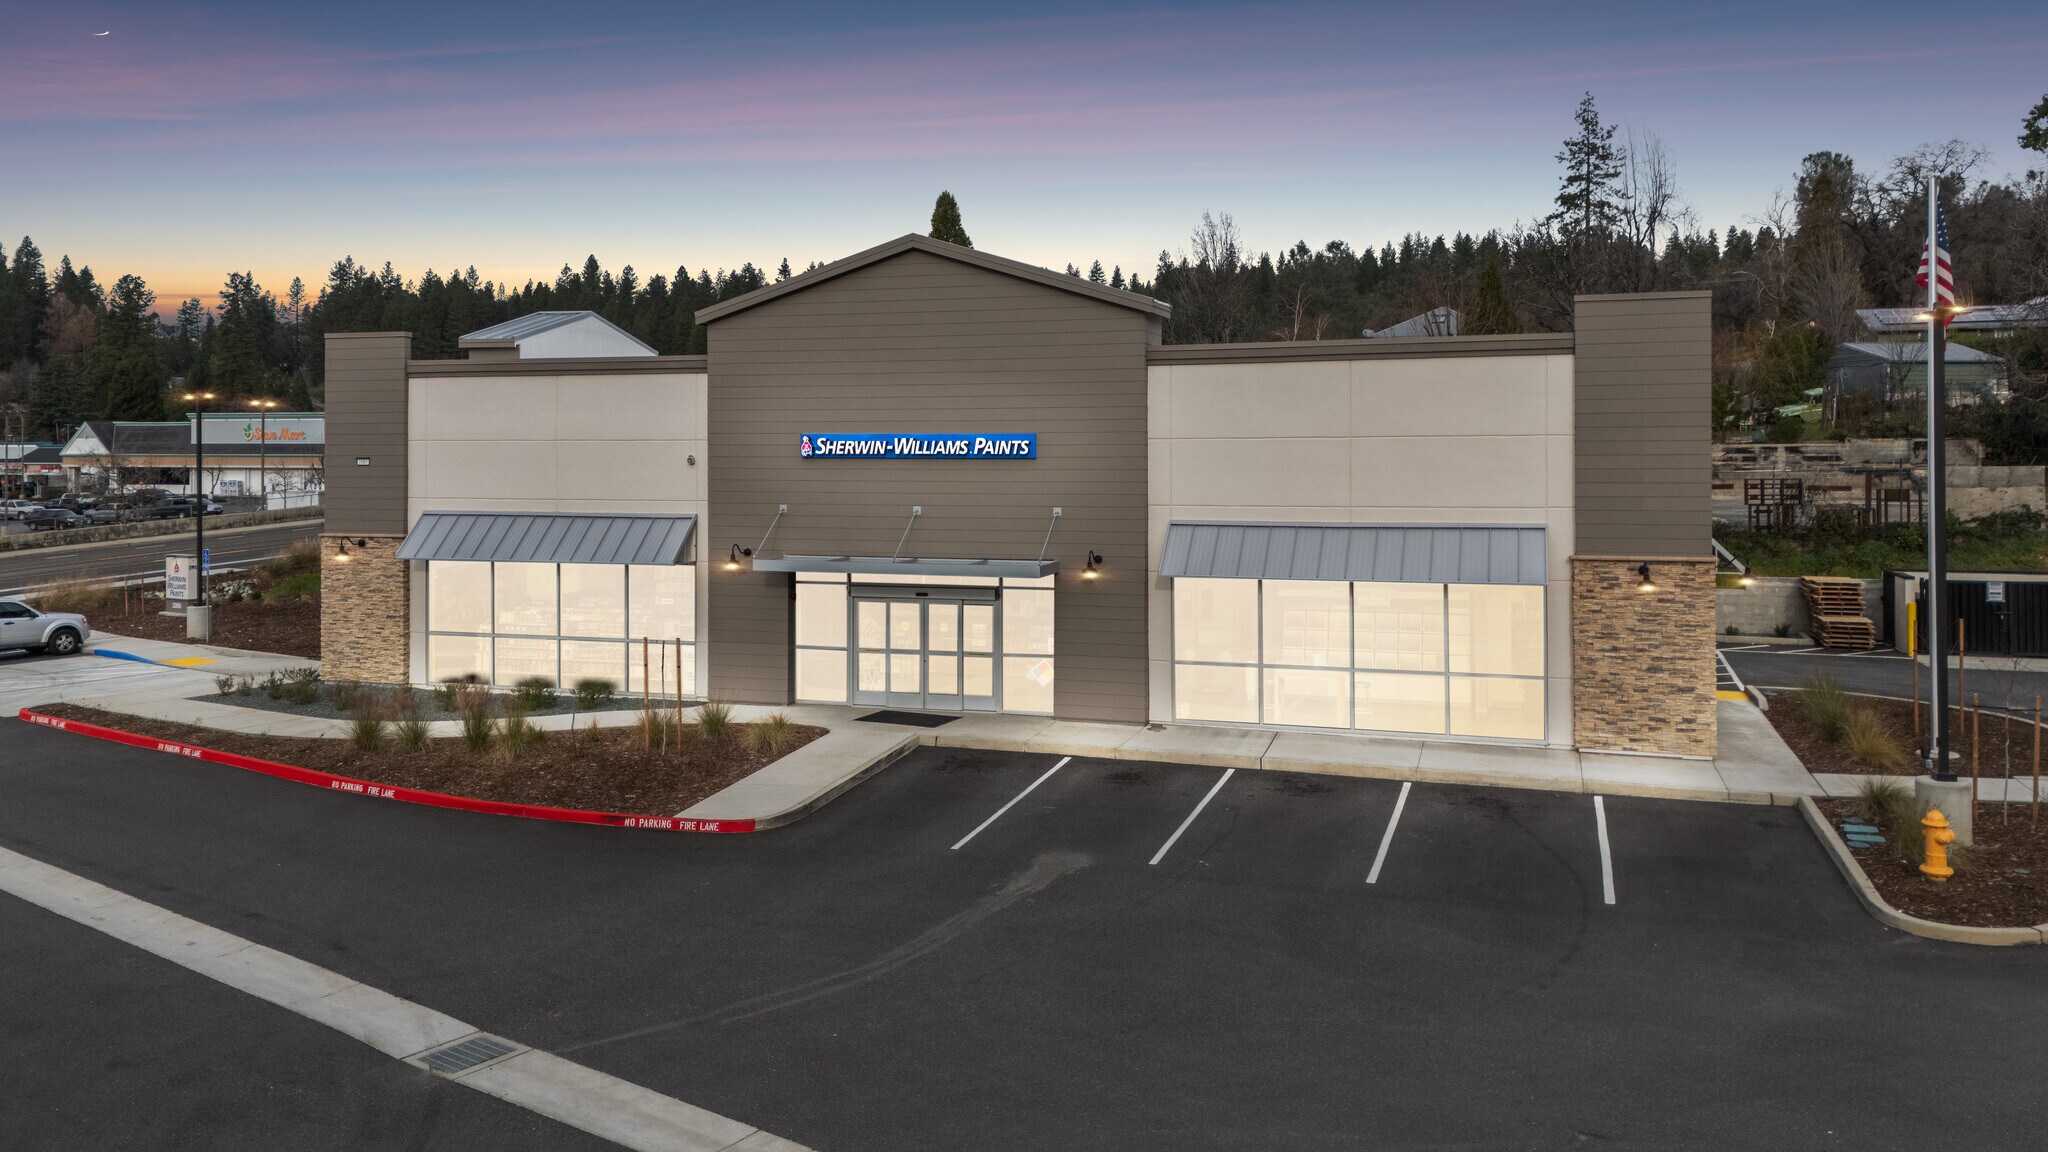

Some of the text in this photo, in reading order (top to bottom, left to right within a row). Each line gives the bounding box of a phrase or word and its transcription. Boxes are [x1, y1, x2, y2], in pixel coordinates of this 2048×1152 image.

[280, 426, 306, 440] Mart
[815, 437, 1030, 455] SHERWIN-WILLIAMS PAINTS
[167, 582, 187, 590] WILLIAMS
[168, 575, 187, 583] SHERWIN
[170, 589, 184, 597] PAINTS
[331, 780, 395, 799] NO PARKING FIRE LANE
[624, 818, 719, 832] NO PARKING FIRE LANE
